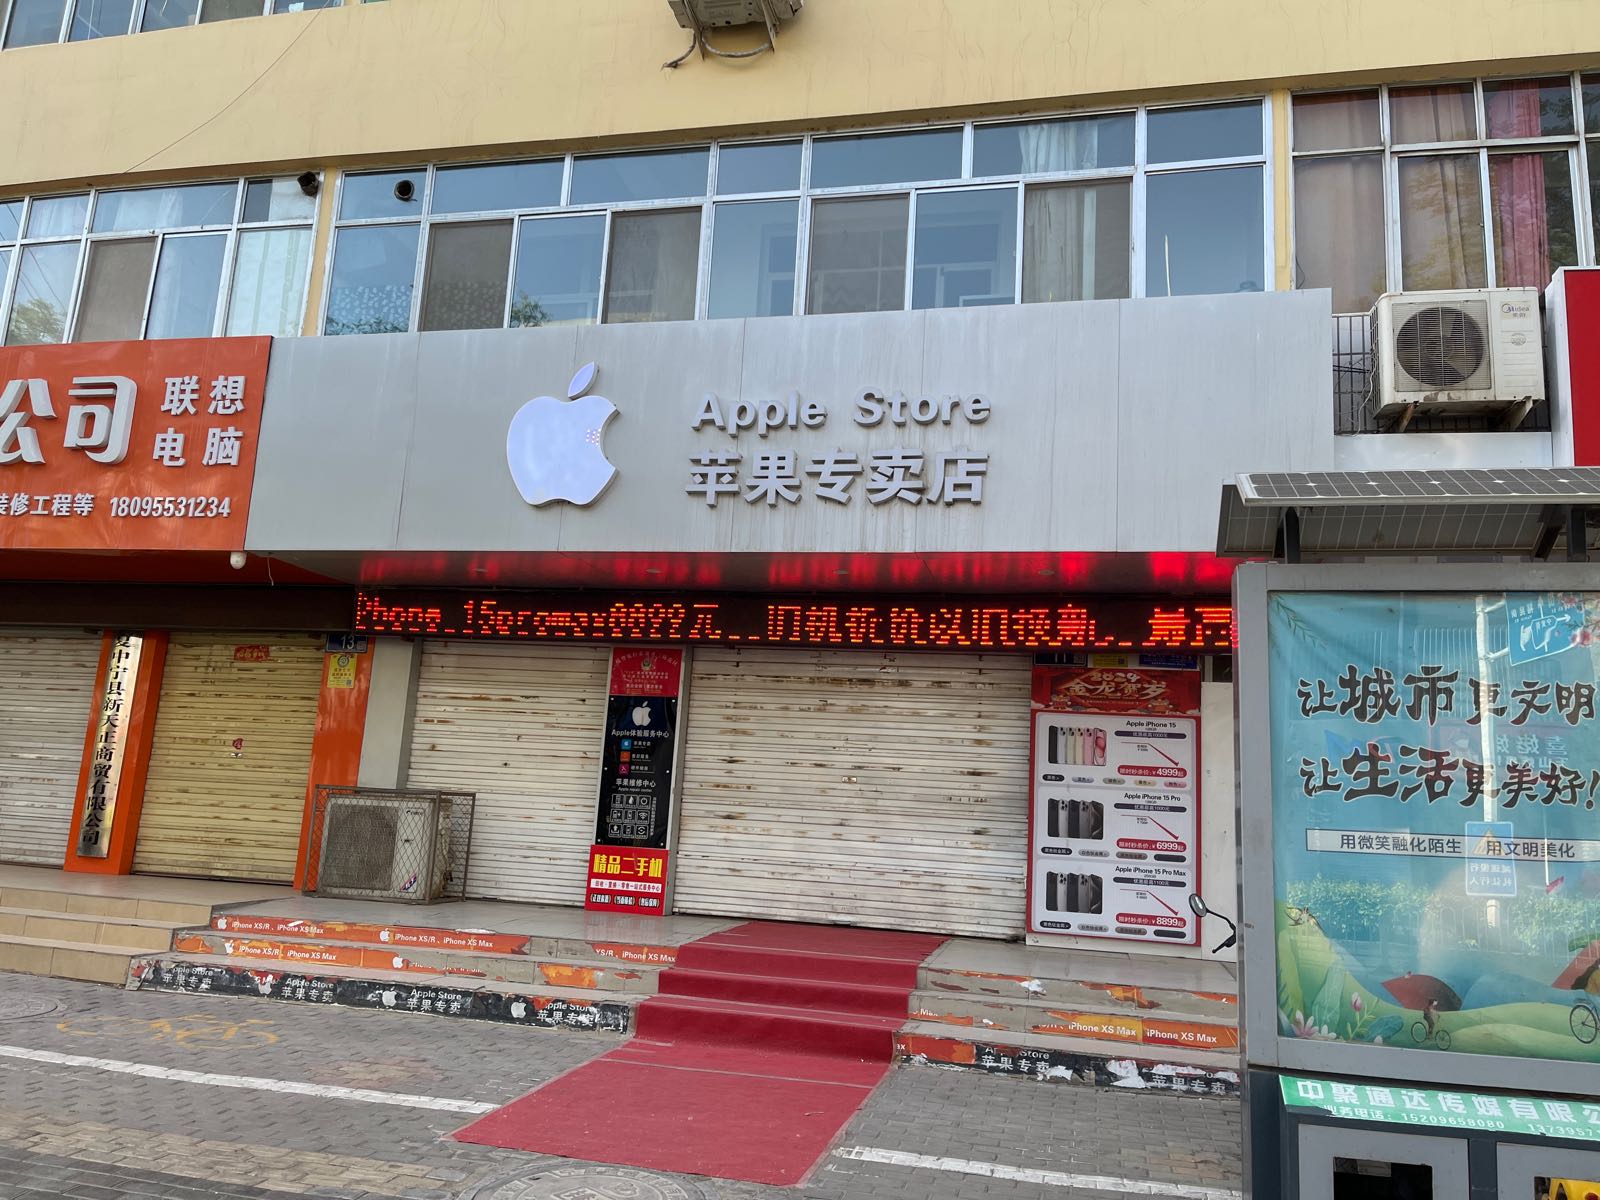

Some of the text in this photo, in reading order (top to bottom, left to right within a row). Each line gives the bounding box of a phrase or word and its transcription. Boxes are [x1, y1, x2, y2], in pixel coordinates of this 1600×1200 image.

[160, 375, 246, 416] 联想
[690, 385, 992, 438] Apple Store
[152, 426, 245, 467] 电脑
[685, 449, 990, 508] 苹果专卖店
[0, 493, 95, 517] 修工程等
[110, 496, 231, 518] 18095531234
[340, 635, 355, 650] 13
[1065, 680, 1168, 699] 金龙贺岁
[1296, 663, 1597, 726] 让城市更文明
[1126, 720, 1145, 728] Apple
[1145, 720, 1168, 728] iPhone
[1124, 792, 1141, 800] Apple
[1141, 793, 1162, 801] iPhone
[1340, 834, 1575, 858] 用微笑融化陌生 用文明美化
[593, 854, 663, 878] 精品二手机
[1115, 865, 1132, 874] Apple
[231, 921, 253, 930] iPhone
[300, 925, 309, 933] XS
[310, 926, 324, 935] Max
[394, 933, 418, 942] iPhone
[443, 937, 466, 946] iPhone
[478, 940, 494, 948] Max
[239, 945, 261, 954] iPhone
[287, 949, 309, 959] iPhone
[310, 951, 321, 960] XS
[322, 952, 337, 961] Max
[622, 951, 646, 960] iPhone
[648, 953, 658, 961] XS
[660, 954, 676, 963] Max
[285, 977, 310, 988] Apple
[311, 979, 334, 989] Store
[282, 986, 334, 1002] 苹果专卖
[410, 988, 462, 1000] Apple Store
[406, 997, 461, 1015] 苹果专卖
[1068, 1021, 1099, 1033] iPhone
[1100, 1024, 1115, 1034] XS
[1116, 1026, 1137, 1036] Max
[1146, 1028, 1217, 1043] iPhone XS Max
[1401, 1112, 1505, 1130] 15209658080
